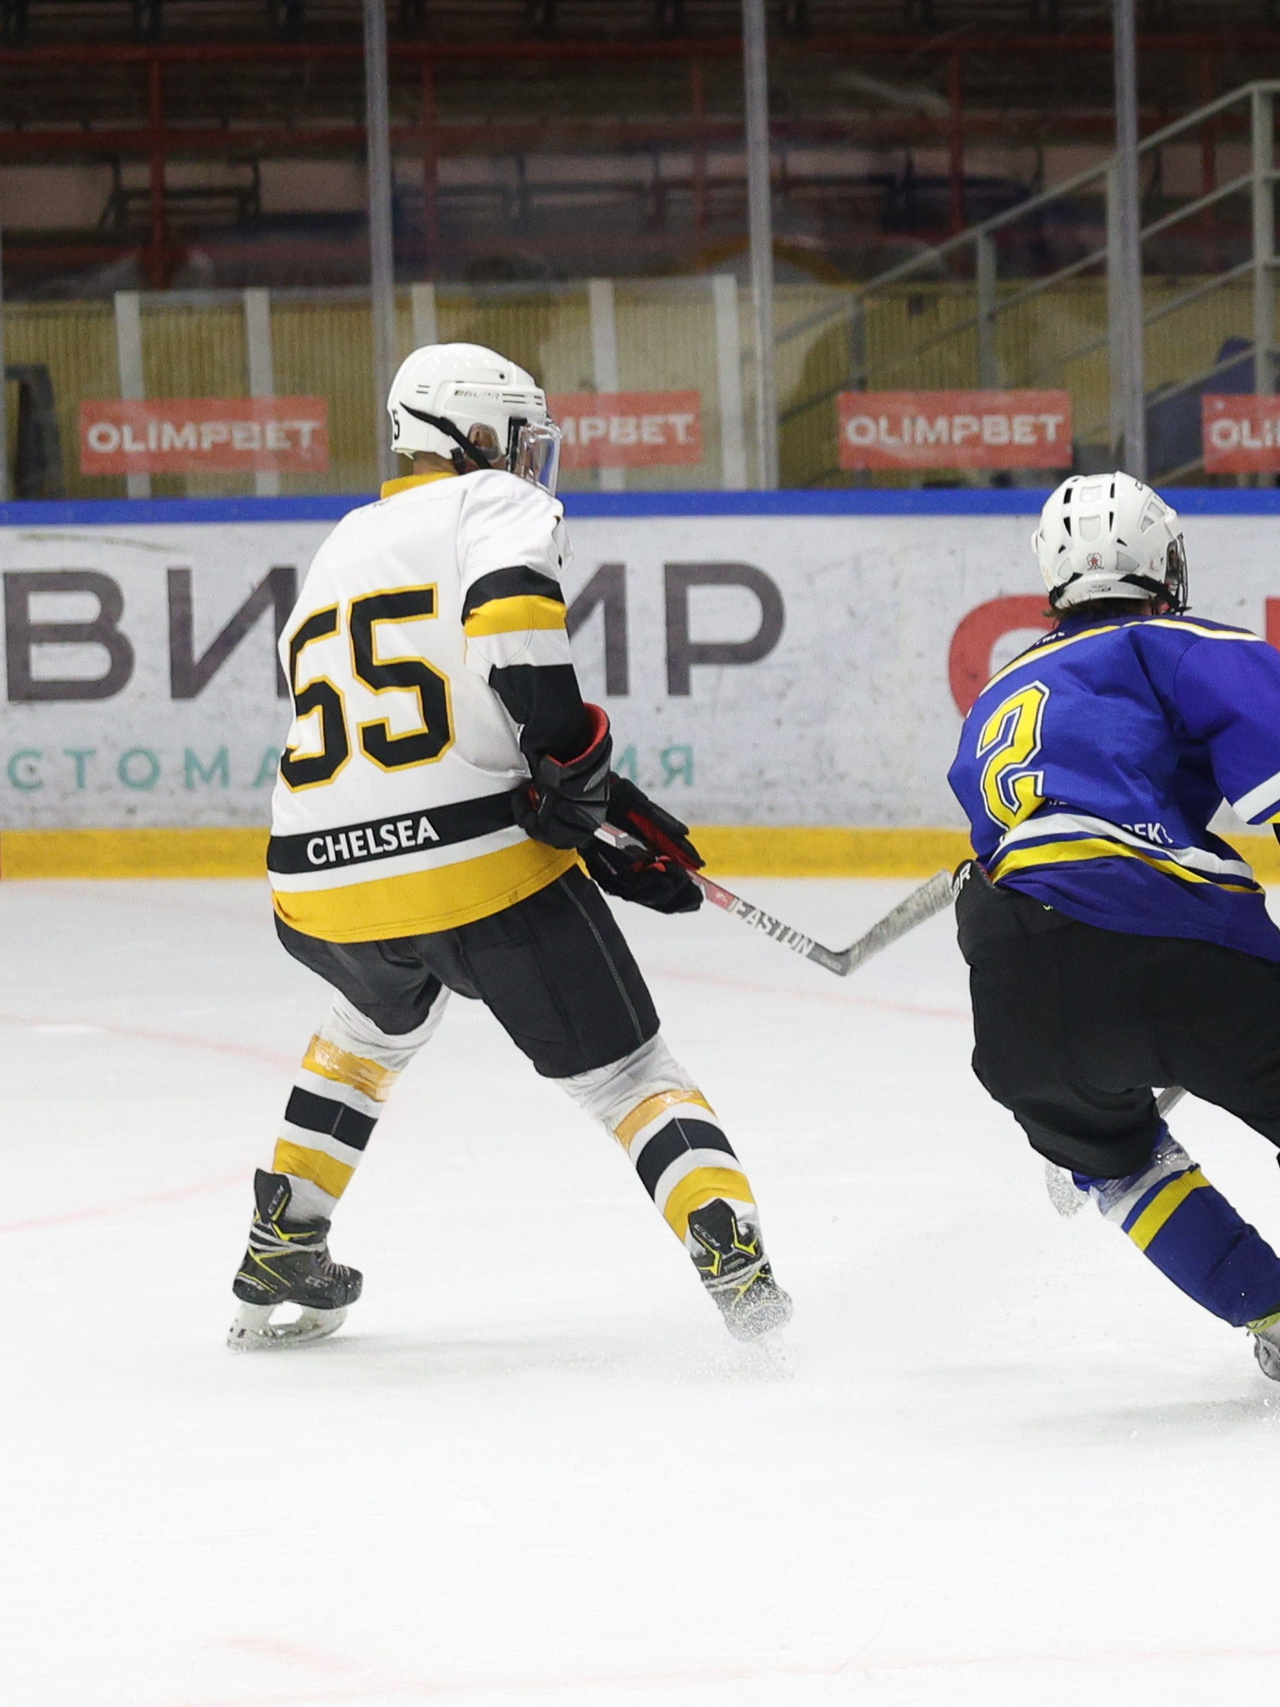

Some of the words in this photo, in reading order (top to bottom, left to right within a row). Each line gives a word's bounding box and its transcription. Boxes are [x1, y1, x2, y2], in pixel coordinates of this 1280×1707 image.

[87, 420, 321, 454] OLIMPBET
[846, 413, 1064, 446] OLIMPBET
[279, 582, 455, 793] 55
[976, 679, 1051, 834] 2
[306, 816, 440, 865] CHELSEA
